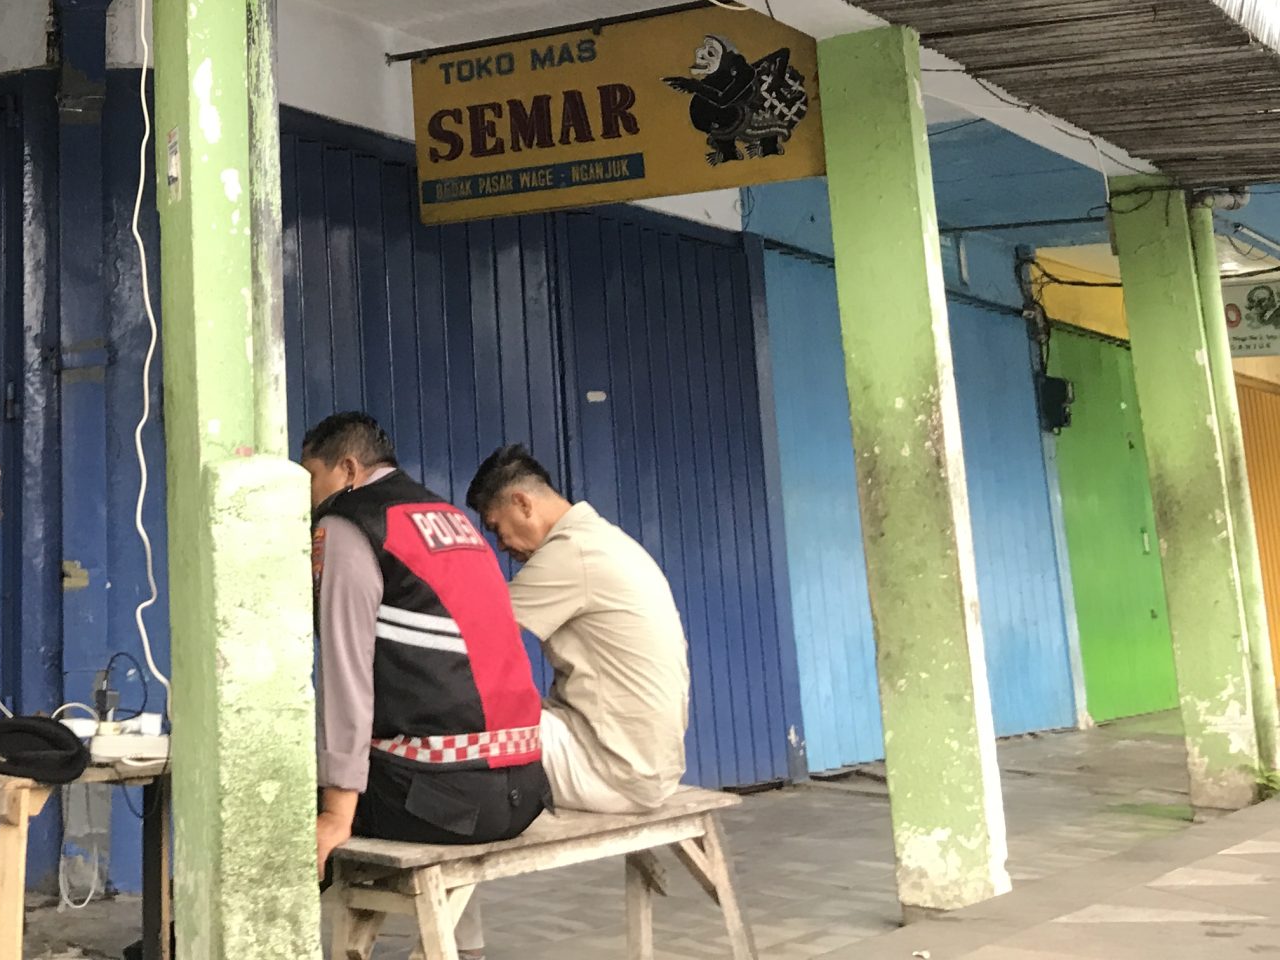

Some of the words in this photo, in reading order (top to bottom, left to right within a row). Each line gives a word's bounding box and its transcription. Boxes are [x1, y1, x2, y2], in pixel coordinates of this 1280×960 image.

[439, 51, 515, 84] TOKO
[529, 38, 598, 71] MAS
[427, 82, 641, 164] SEMAR
[477, 176, 514, 195] PASAR
[519, 167, 554, 189] WAGE
[570, 159, 630, 183] NGANJUK
[411, 511, 486, 549] POLISI
